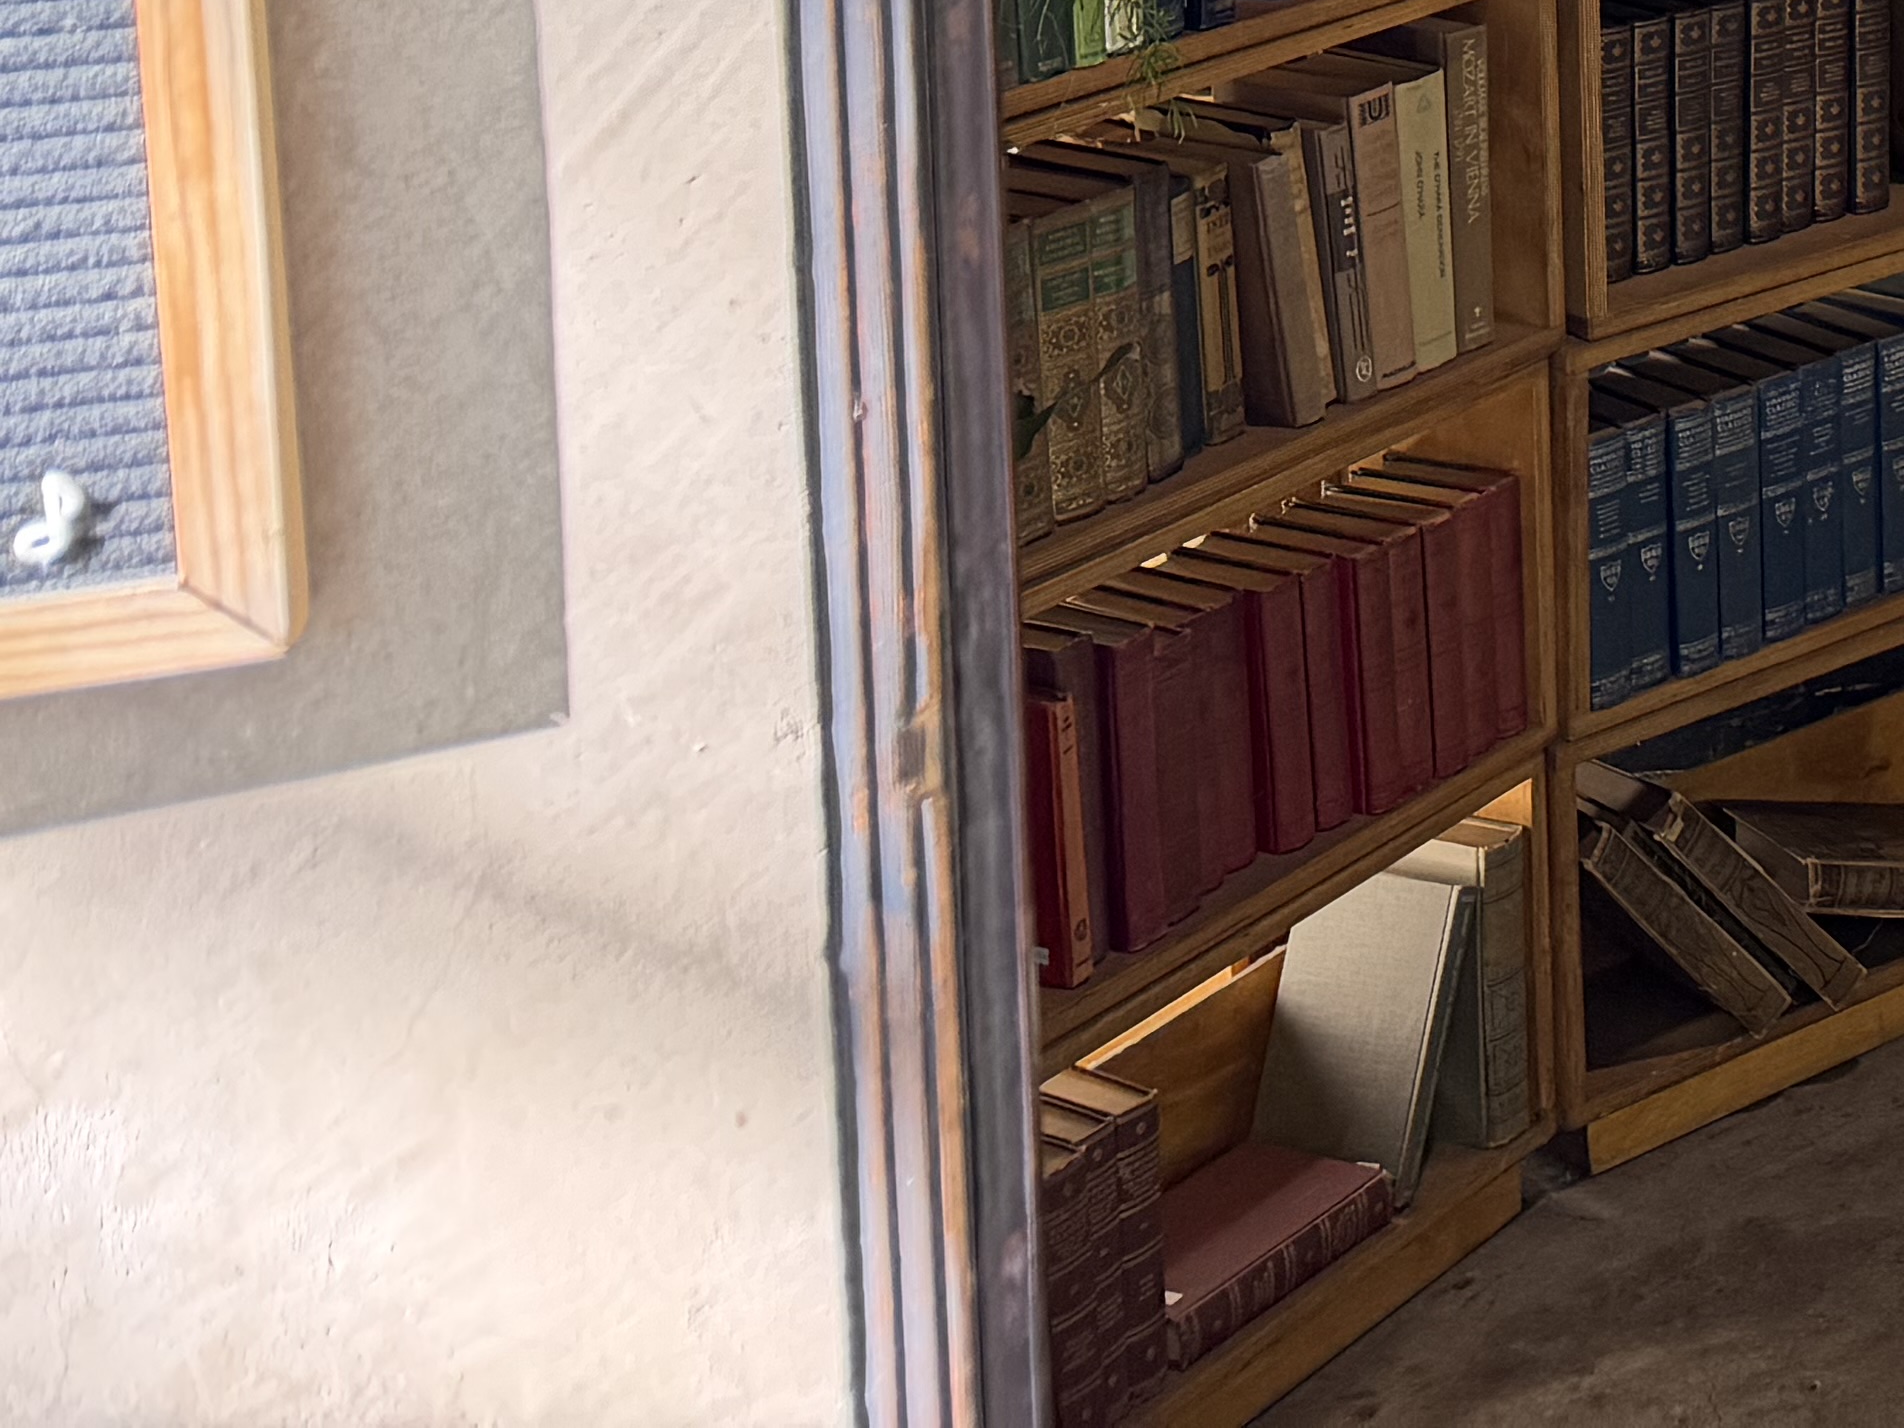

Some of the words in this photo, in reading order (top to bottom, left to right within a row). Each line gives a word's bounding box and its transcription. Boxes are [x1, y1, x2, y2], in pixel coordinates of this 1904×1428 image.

[1461, 38, 1477, 117] MOZART
[1465, 123, 1479, 145] IN
[1465, 150, 1482, 224] VIENNA
